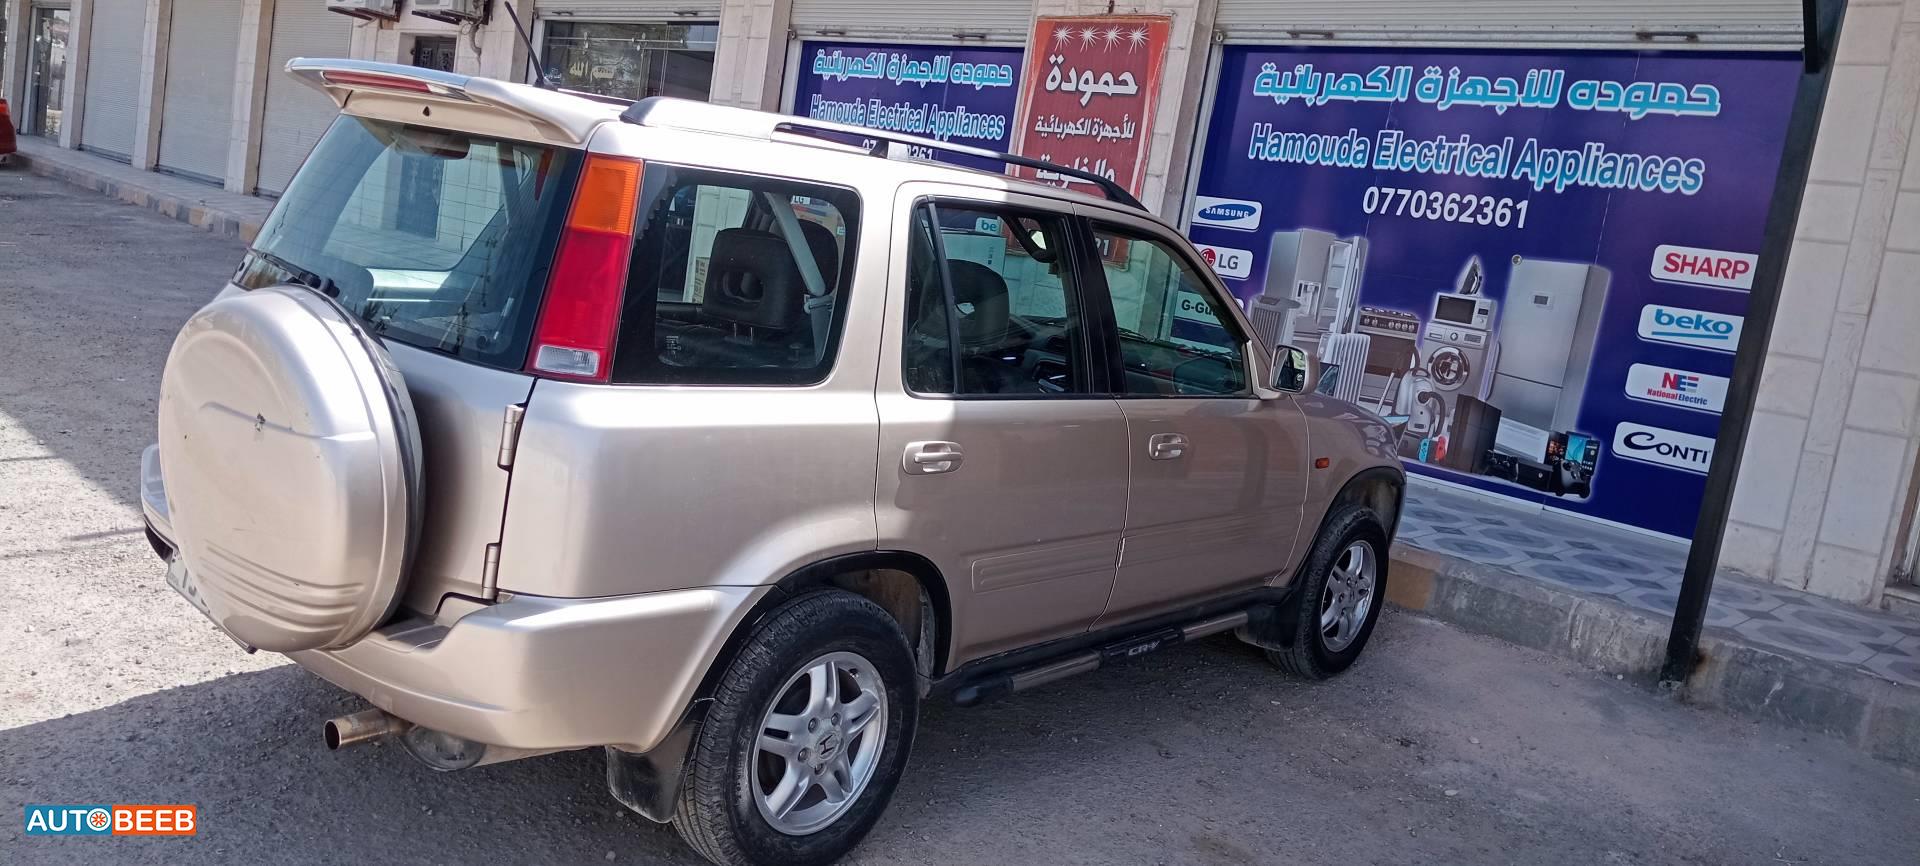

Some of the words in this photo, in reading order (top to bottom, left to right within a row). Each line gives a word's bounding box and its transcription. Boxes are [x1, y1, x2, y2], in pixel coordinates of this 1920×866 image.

[813, 49, 886, 82] الكهربائية
[951, 62, 1013, 90] حموده
[1045, 54, 1138, 107] حمودة
[1253, 62, 1413, 107] الكهربائية
[1415, 66, 1565, 116] للأجهزة
[1567, 80, 1721, 120] حموده
[810, 94, 867, 126] Hamouda
[867, 98, 927, 133] Electrical
[927, 103, 1006, 141] Appliances
[1034, 114, 1091, 140] الكهربائية
[1091, 114, 1136, 143] للأجهزة
[1248, 123, 1370, 169] Hamouda
[1372, 129, 1514, 179] Electrical
[1512, 137, 1706, 195] Appliances
[1205, 206, 1250, 219] SAMSUNG
[1362, 186, 1529, 229] 0770362361
[1218, 253, 1239, 270] LG
[1663, 252, 1750, 280] SHARP
[1182, 299, 1216, 316] G-Gu
[1654, 308, 1734, 335] beko
[1647, 388, 1678, 400] National
[1678, 393, 1708, 406] Electric
[1623, 431, 1708, 464] CONTI
